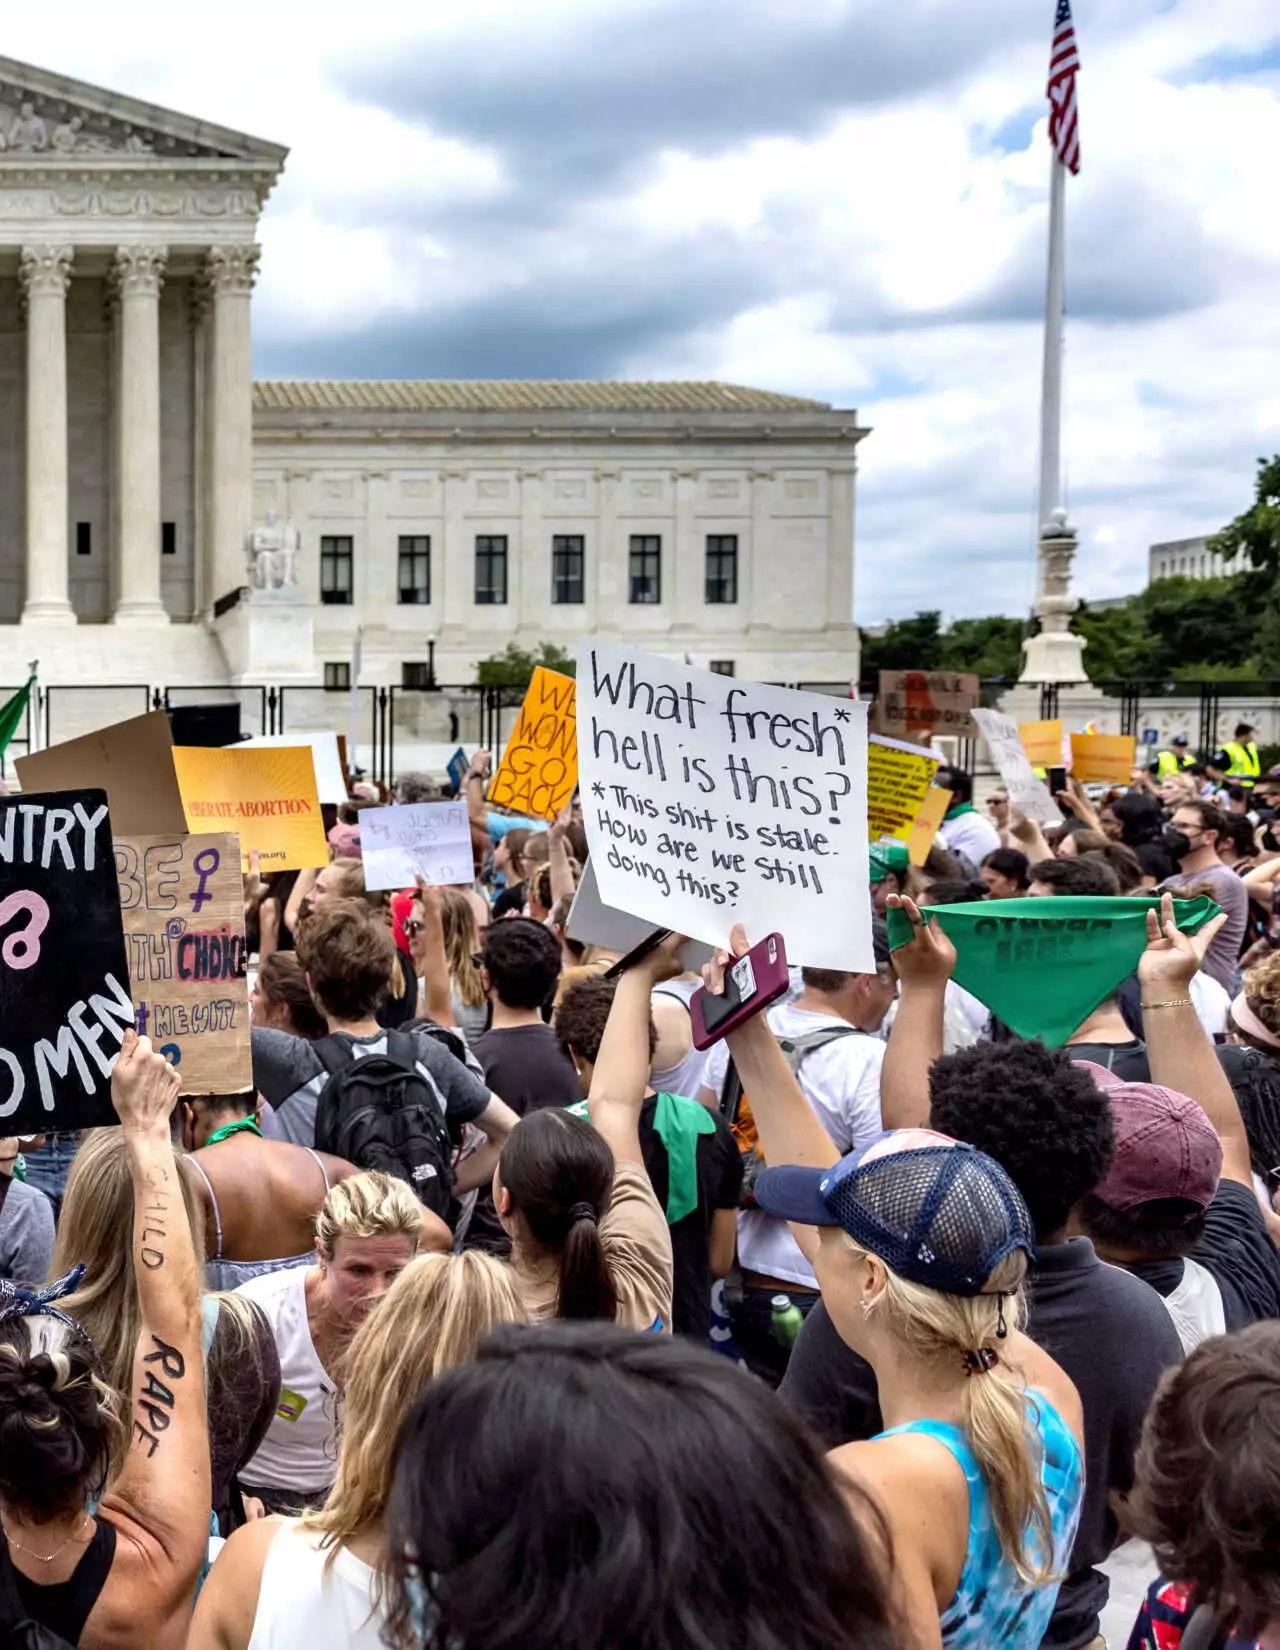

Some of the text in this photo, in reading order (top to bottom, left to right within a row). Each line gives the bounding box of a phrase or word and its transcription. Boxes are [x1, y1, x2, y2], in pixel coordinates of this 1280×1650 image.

[592, 650, 706, 729] What
[492, 768, 571, 820] BACK
[509, 746, 566, 786] GO
[592, 717, 851, 824] hell is this?
[236, 798, 312, 818] ABORTION
[666, 802, 717, 832] shit
[726, 815, 749, 840] is
[597, 809, 648, 846] How
[657, 833, 699, 862] are
[712, 850, 746, 873] we
[113, 843, 183, 910] BE
[607, 844, 739, 907] doing this?
[34, 973, 135, 1112] MEN
[154, 1004, 189, 1038] ME
[140, 1166, 168, 1270] CHILD
[134, 1335, 185, 1458] RAPE
